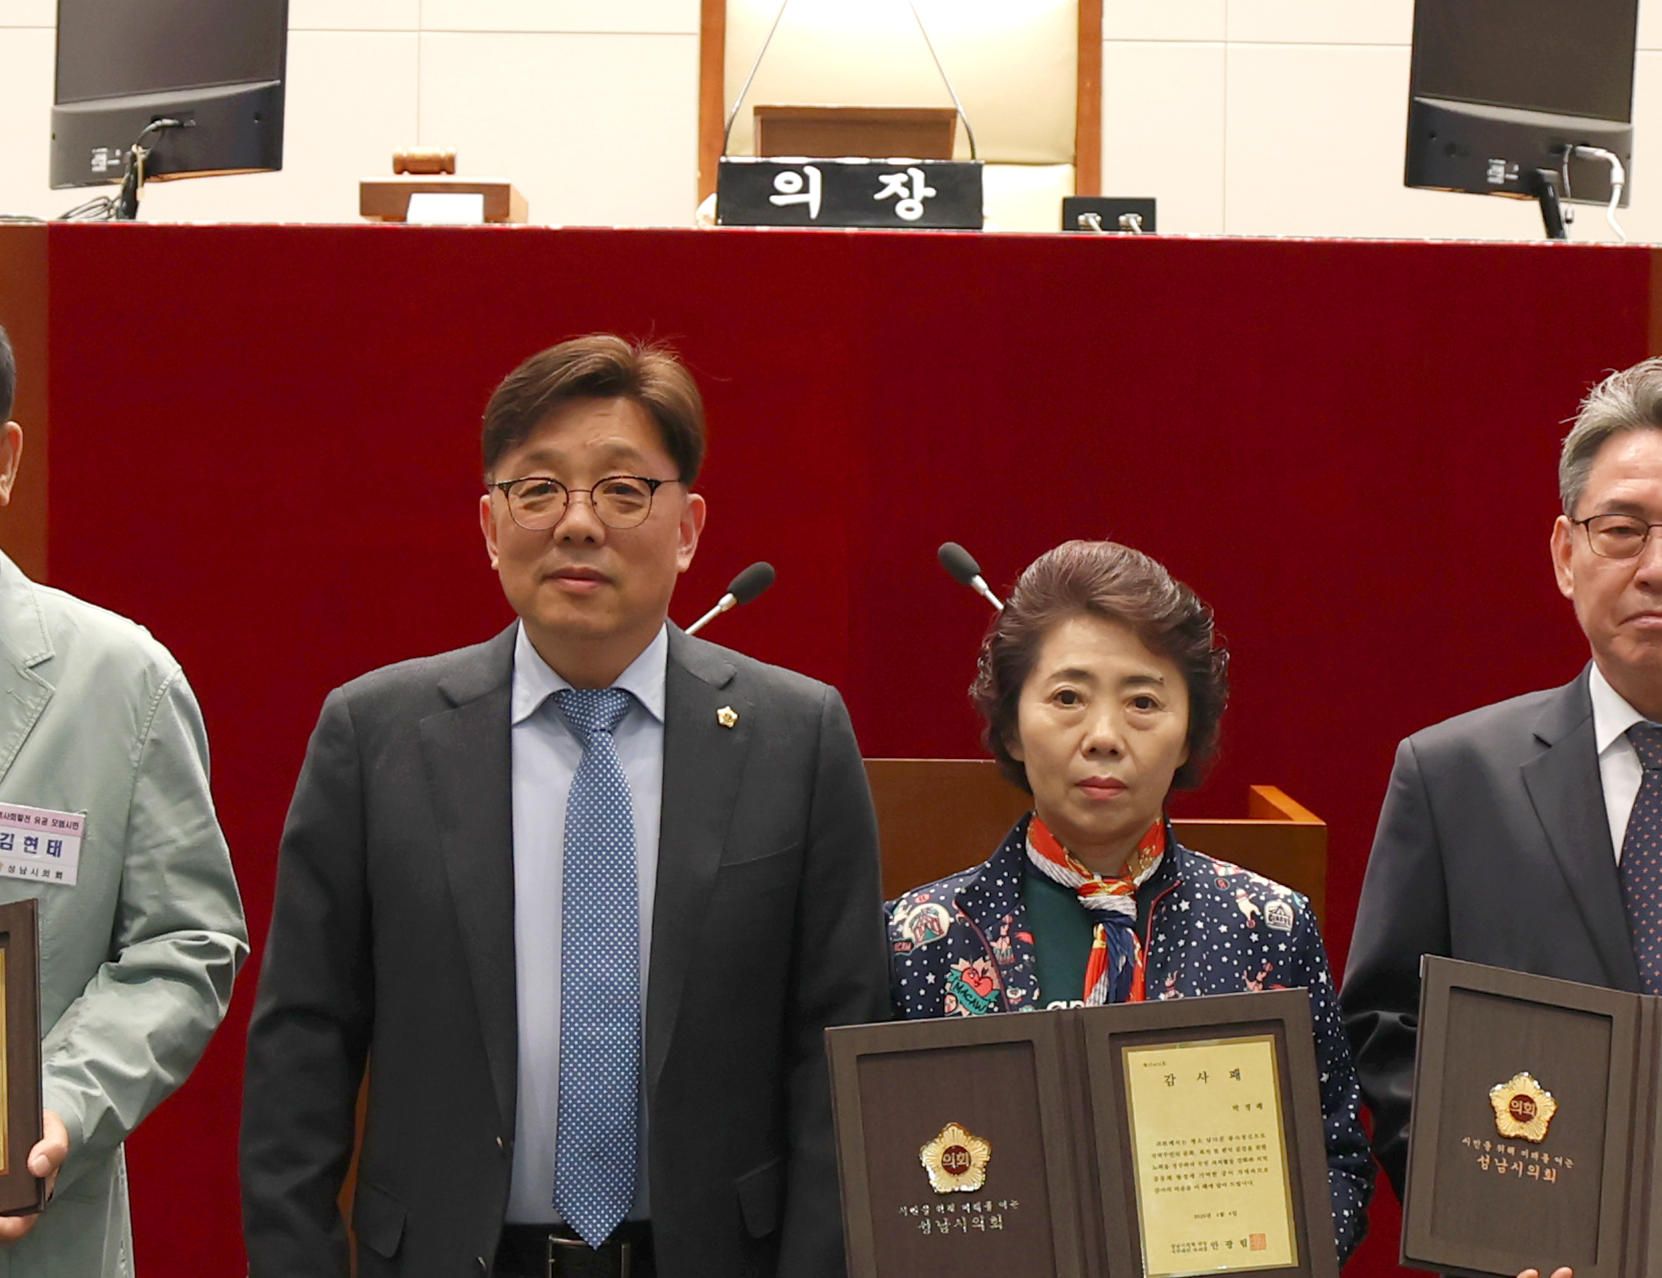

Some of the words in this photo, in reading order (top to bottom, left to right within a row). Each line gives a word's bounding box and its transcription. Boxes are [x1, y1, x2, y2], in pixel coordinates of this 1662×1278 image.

[1510, 1100, 1536, 1117] 의회
[942, 1151, 969, 1169] 의회
[1476, 1153, 1558, 1184] 성남시의회
[917, 1214, 1003, 1235] 성남시의회
